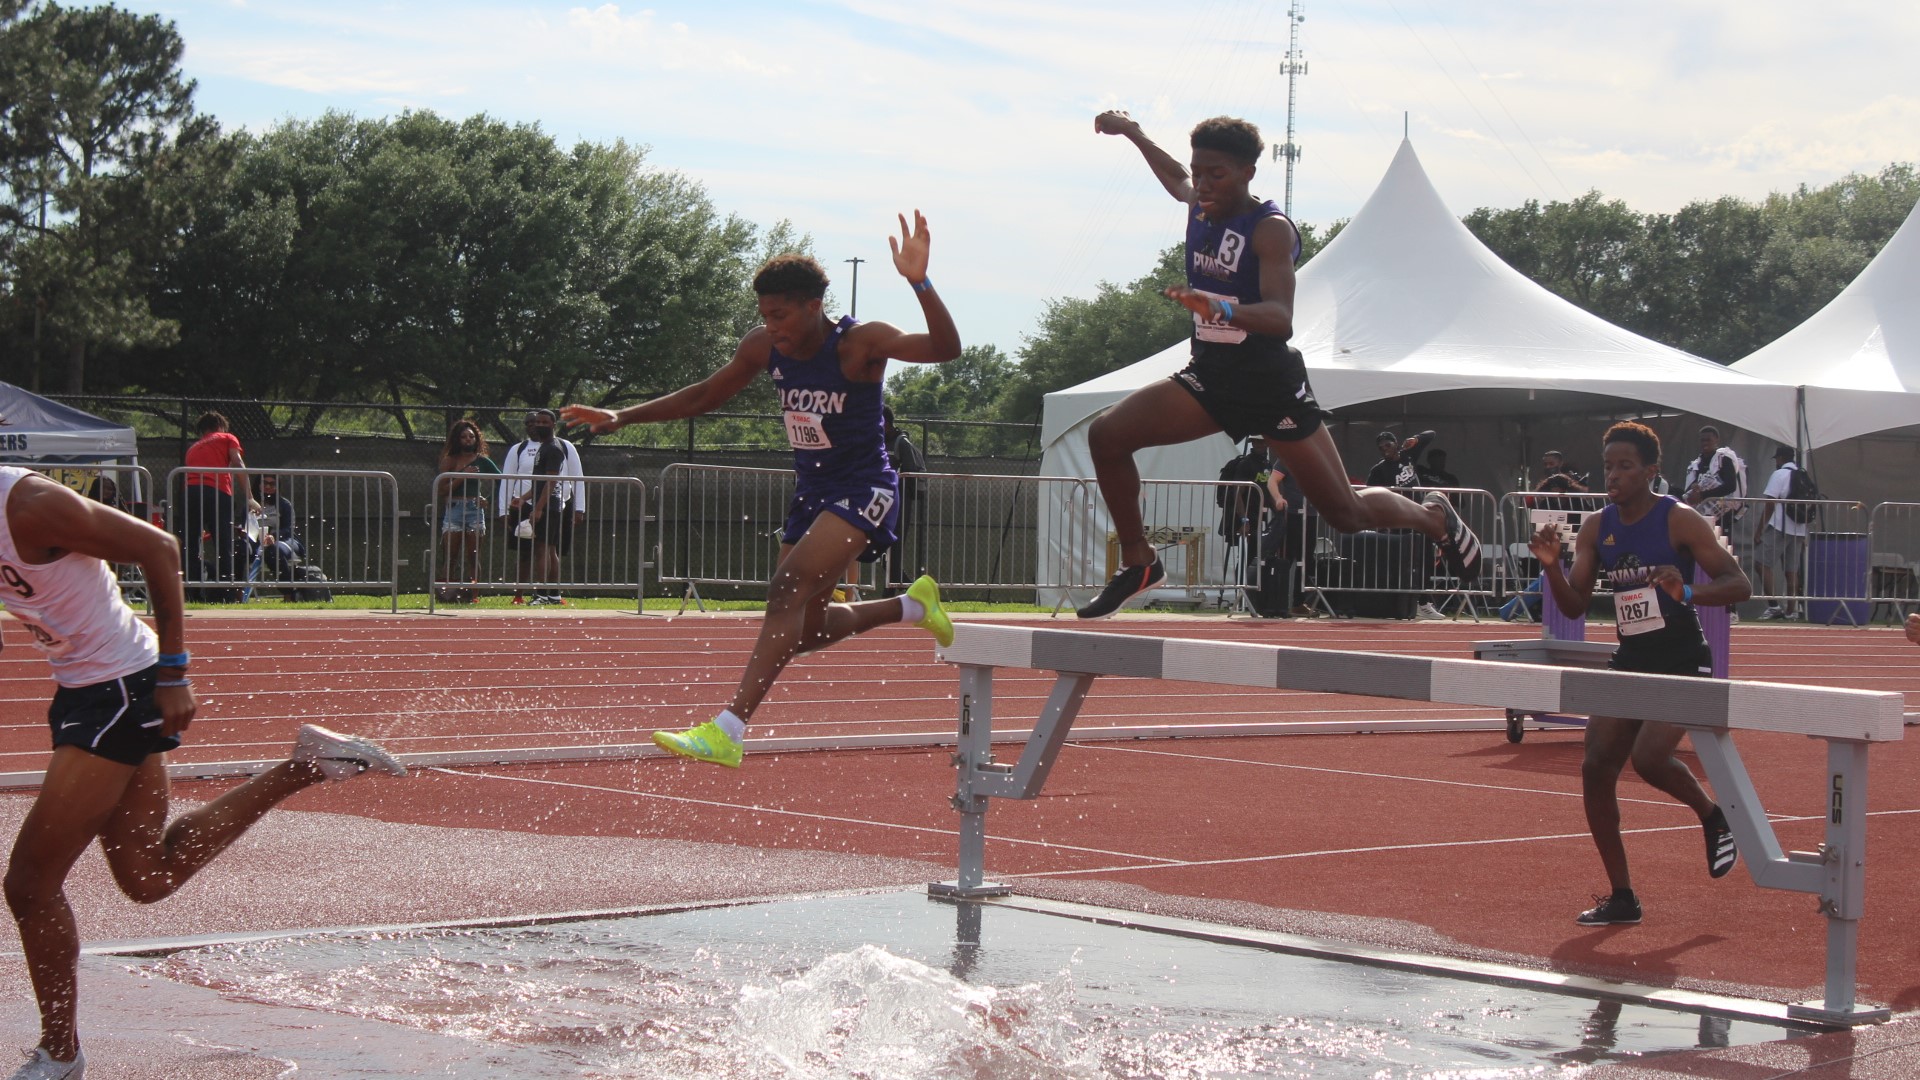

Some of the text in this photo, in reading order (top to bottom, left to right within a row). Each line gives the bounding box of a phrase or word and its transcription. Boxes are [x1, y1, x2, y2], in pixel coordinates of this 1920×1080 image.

[1193, 251, 1231, 277] PVA
[1220, 233, 1240, 266] 3
[778, 388, 847, 414] LCORN
[792, 424, 820, 443] 1196
[868, 491, 890, 522] 5
[1, 565, 36, 598] 9
[1620, 601, 1649, 621] 1267
[963, 694, 971, 736] UCS
[1832, 774, 1842, 824] UCS
